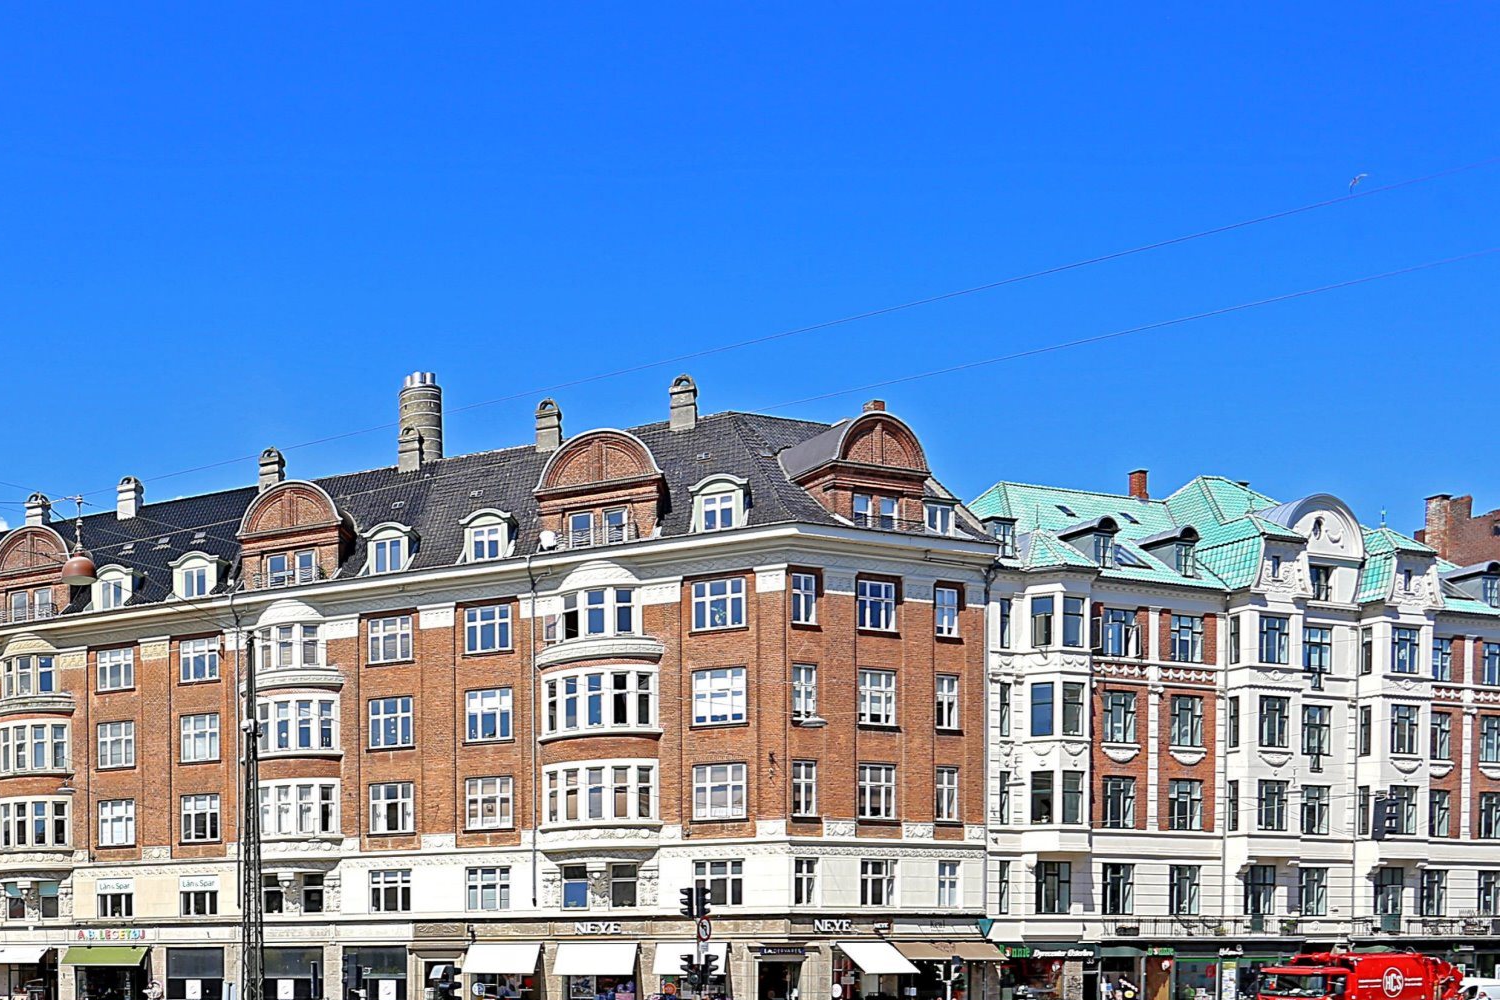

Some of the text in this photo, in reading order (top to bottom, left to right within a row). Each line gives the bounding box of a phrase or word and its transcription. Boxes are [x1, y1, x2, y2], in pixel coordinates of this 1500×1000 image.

[115, 882, 130, 891] Spar
[199, 879, 215, 888] Spar
[574, 921, 622, 934] NEYE
[813, 919, 852, 932] NEYE
[1385, 973, 1402, 992] HCS
